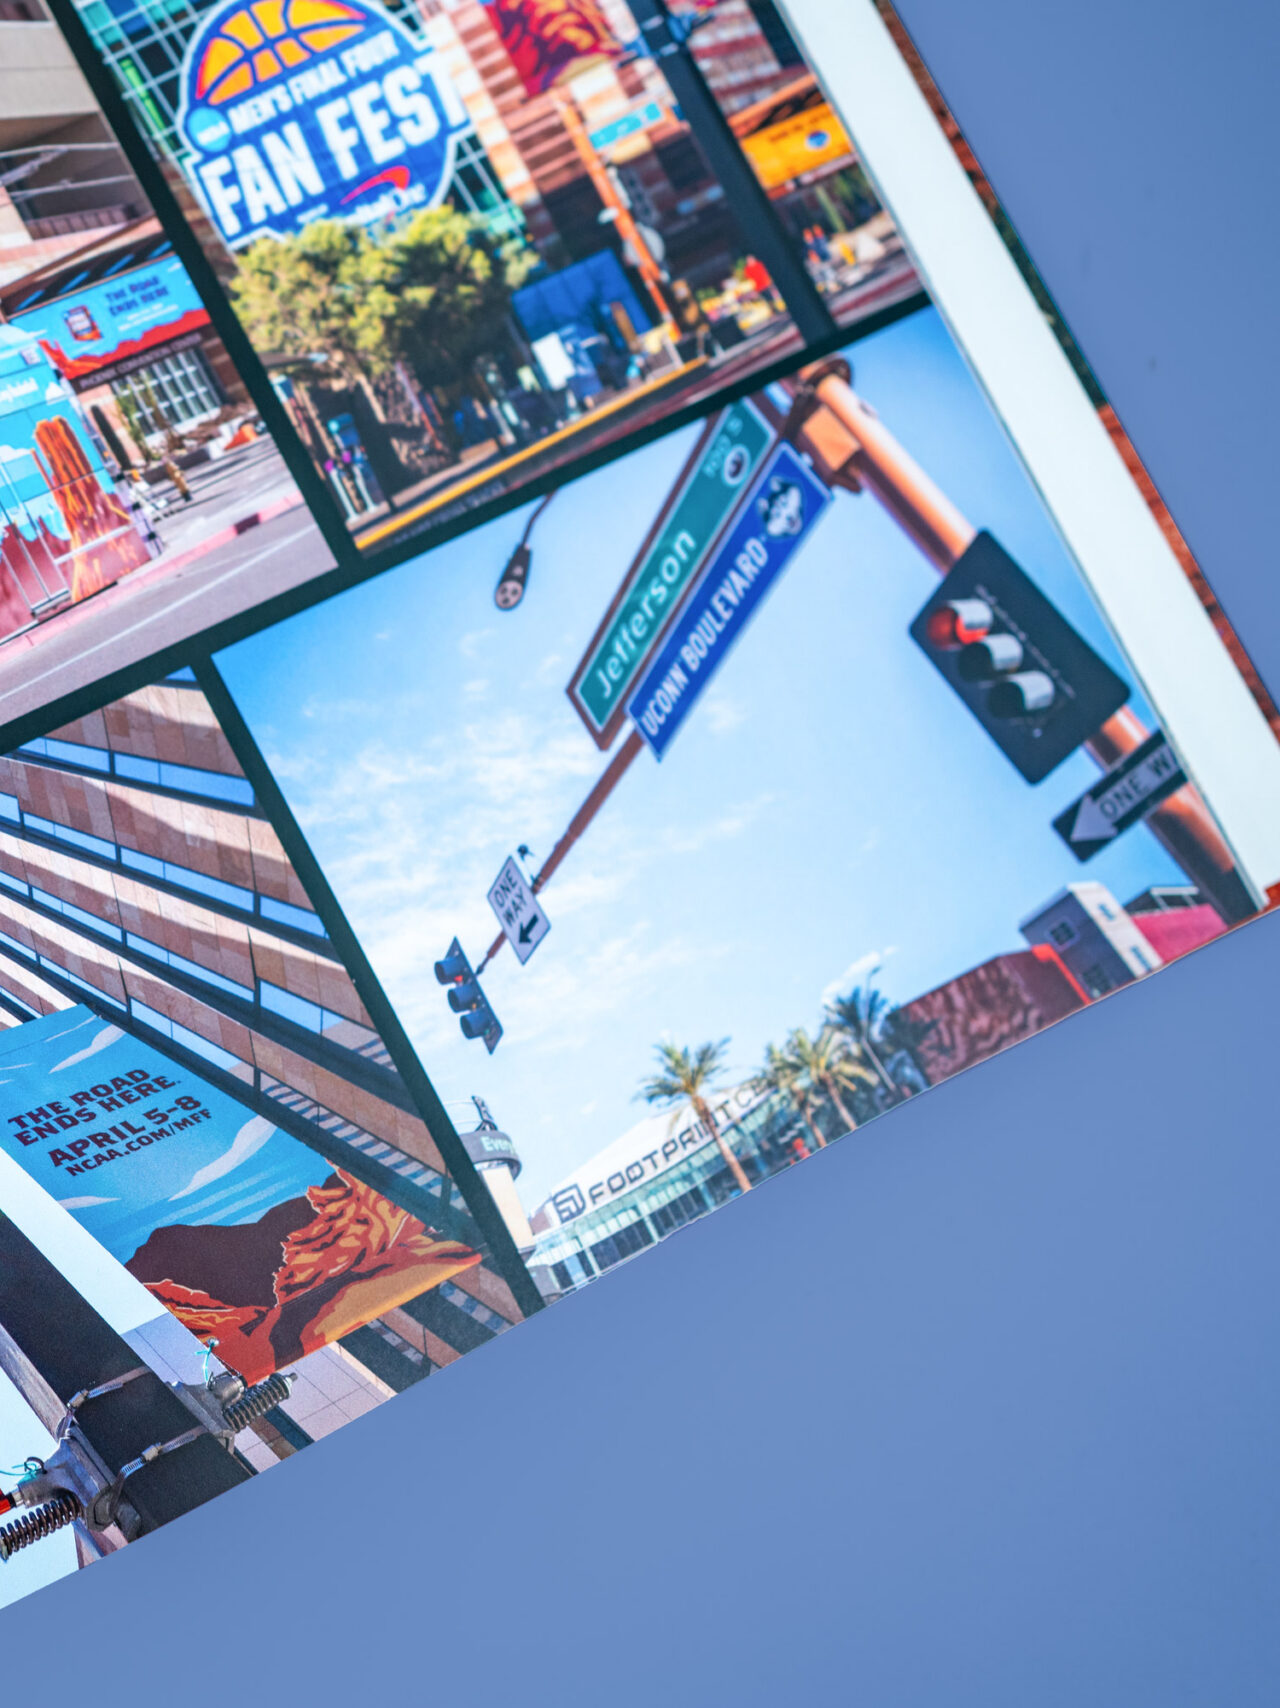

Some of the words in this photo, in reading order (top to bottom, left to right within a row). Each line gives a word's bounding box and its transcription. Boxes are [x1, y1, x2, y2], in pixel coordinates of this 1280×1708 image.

[287, 58, 348, 105] FINAL
[340, 30, 400, 77] FOUR
[198, 120, 326, 237] FAN
[316, 50, 471, 181] FEST
[595, 530, 697, 698] Jefferson
[641, 659, 690, 736] UCONN
[681, 537, 769, 671] BOULEVARD
[1099, 774, 1151, 820] ONE
[494, 869, 518, 908] ONE
[502, 888, 528, 928] WAY
[7, 1101, 70, 1130] THE
[69, 1069, 150, 1106] ROAD
[13, 1107, 97, 1147] ENDS
[99, 1075, 181, 1112] HERE.
[48, 1120, 146, 1167] APRIL
[141, 1095, 202, 1125] 5-8
[64, 1108, 212, 1177] NCAA.COM/MFF
